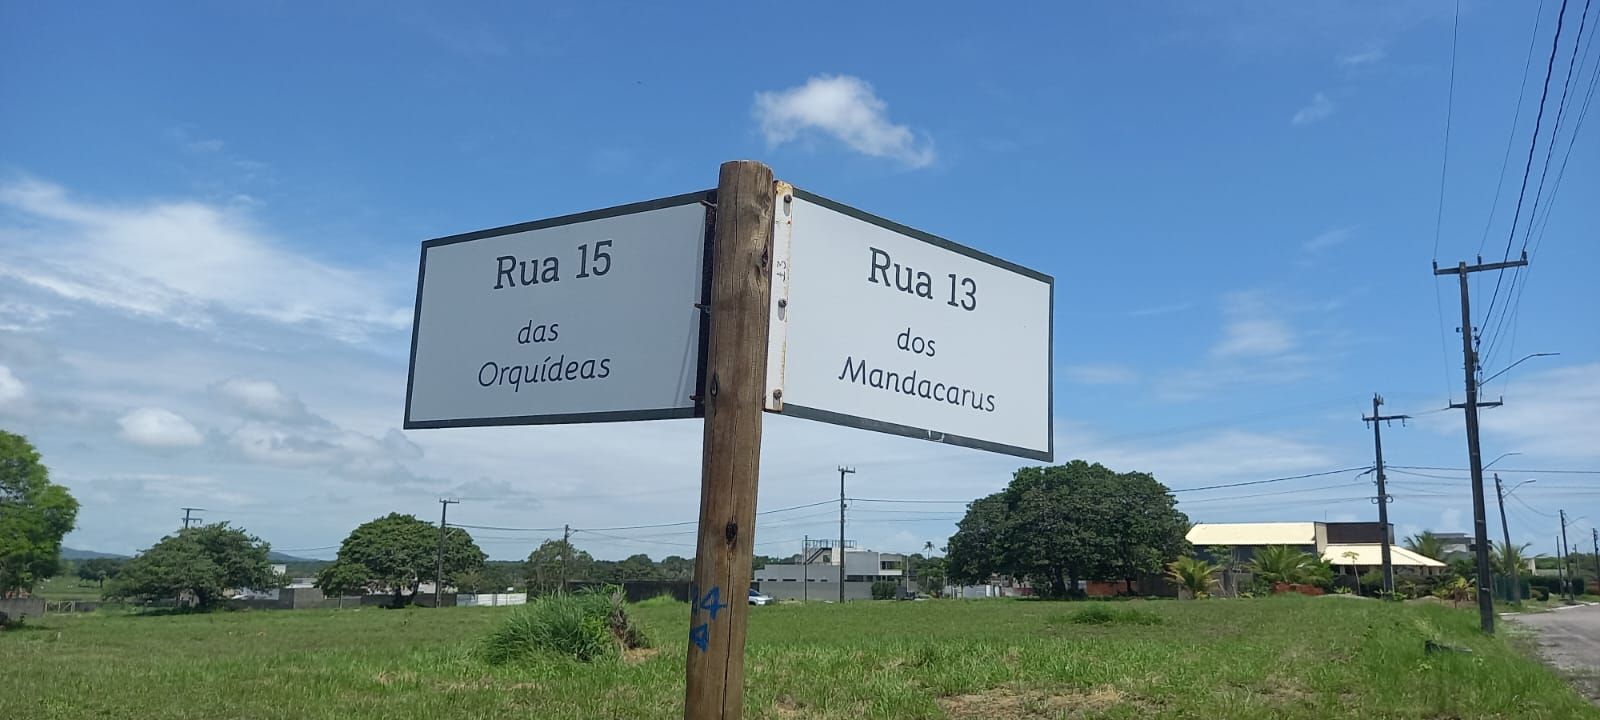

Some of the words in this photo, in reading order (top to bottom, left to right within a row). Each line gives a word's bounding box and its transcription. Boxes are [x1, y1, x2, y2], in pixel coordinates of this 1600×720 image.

[493, 255, 560, 290] Rua
[575, 239, 613, 279] 15
[867, 246, 934, 300] Rua
[946, 273, 977, 312] 13
[517, 319, 560, 345] das
[896, 327, 936, 357] dos
[477, 353, 612, 393] Orquídeas
[837, 356, 996, 412] Mandacarus
